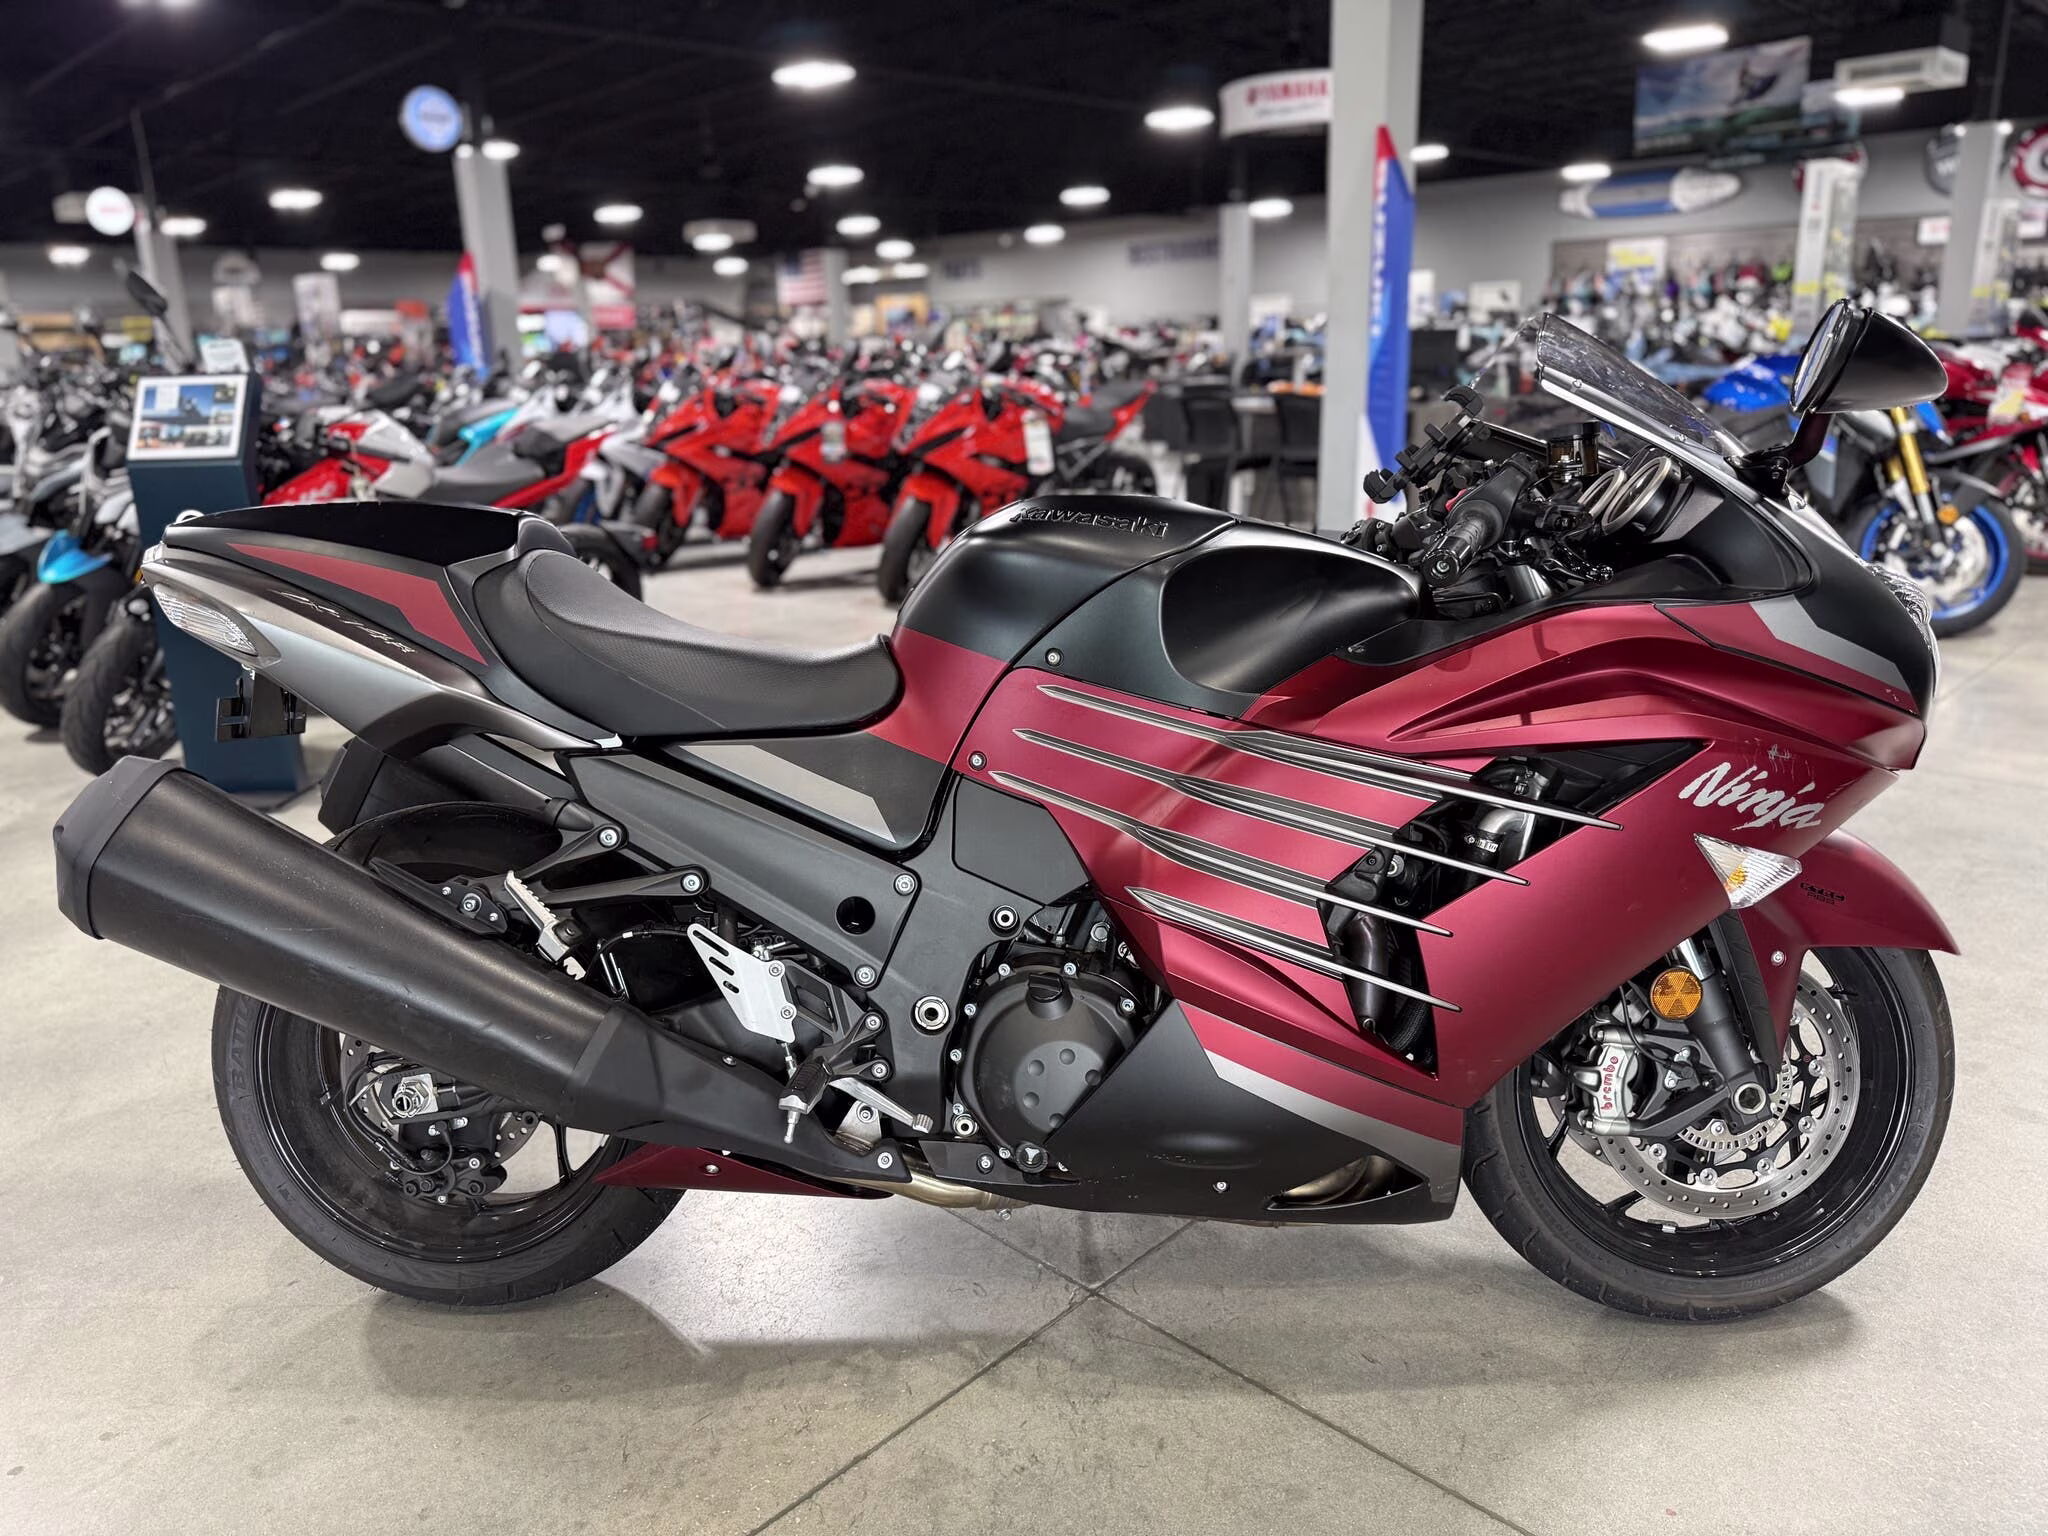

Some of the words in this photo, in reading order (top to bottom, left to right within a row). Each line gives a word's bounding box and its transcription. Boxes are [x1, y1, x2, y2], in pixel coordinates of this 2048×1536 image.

[1009, 507, 1169, 538] Kawasaki
[1678, 762, 1825, 831] Ninja
[1600, 1055, 1619, 1111] brembo
